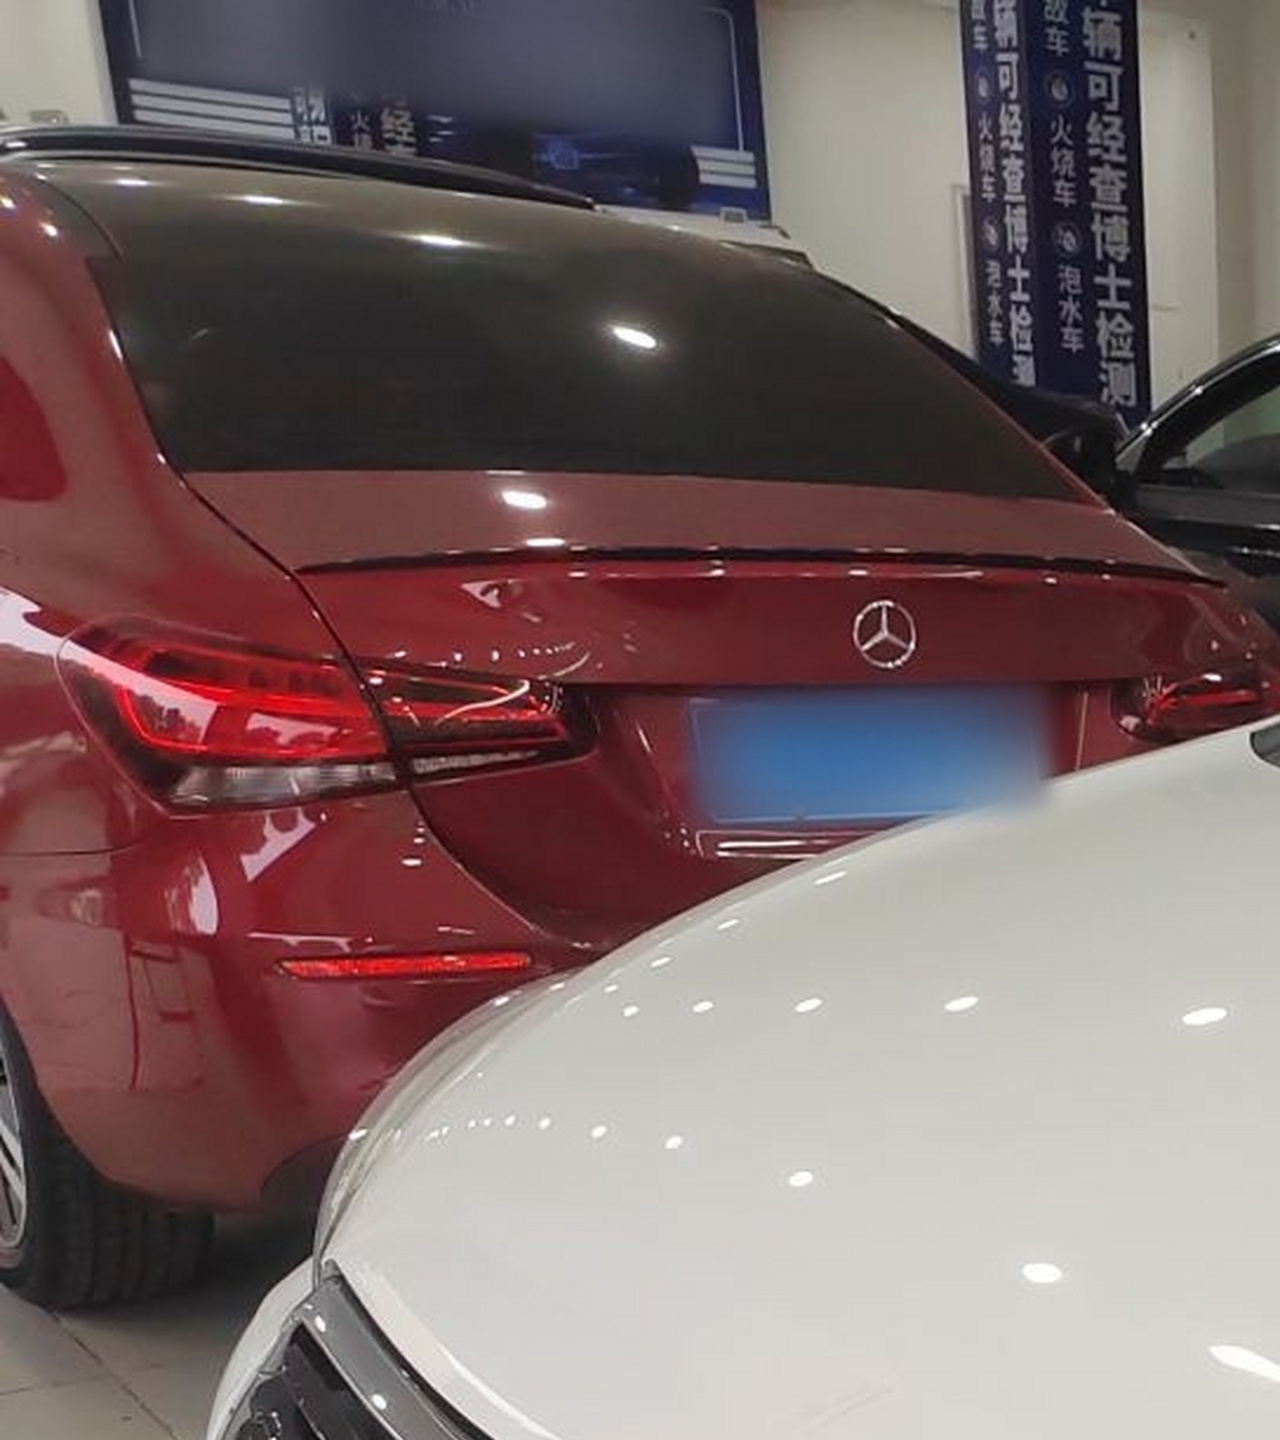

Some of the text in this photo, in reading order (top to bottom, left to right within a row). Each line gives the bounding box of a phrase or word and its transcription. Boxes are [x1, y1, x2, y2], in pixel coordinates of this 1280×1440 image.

[1050, 116, 1077, 208] 火烧车
[1082, 0, 1136, 408] 辆可经查博士检测
[1057, 264, 1084, 354] 泡水车
